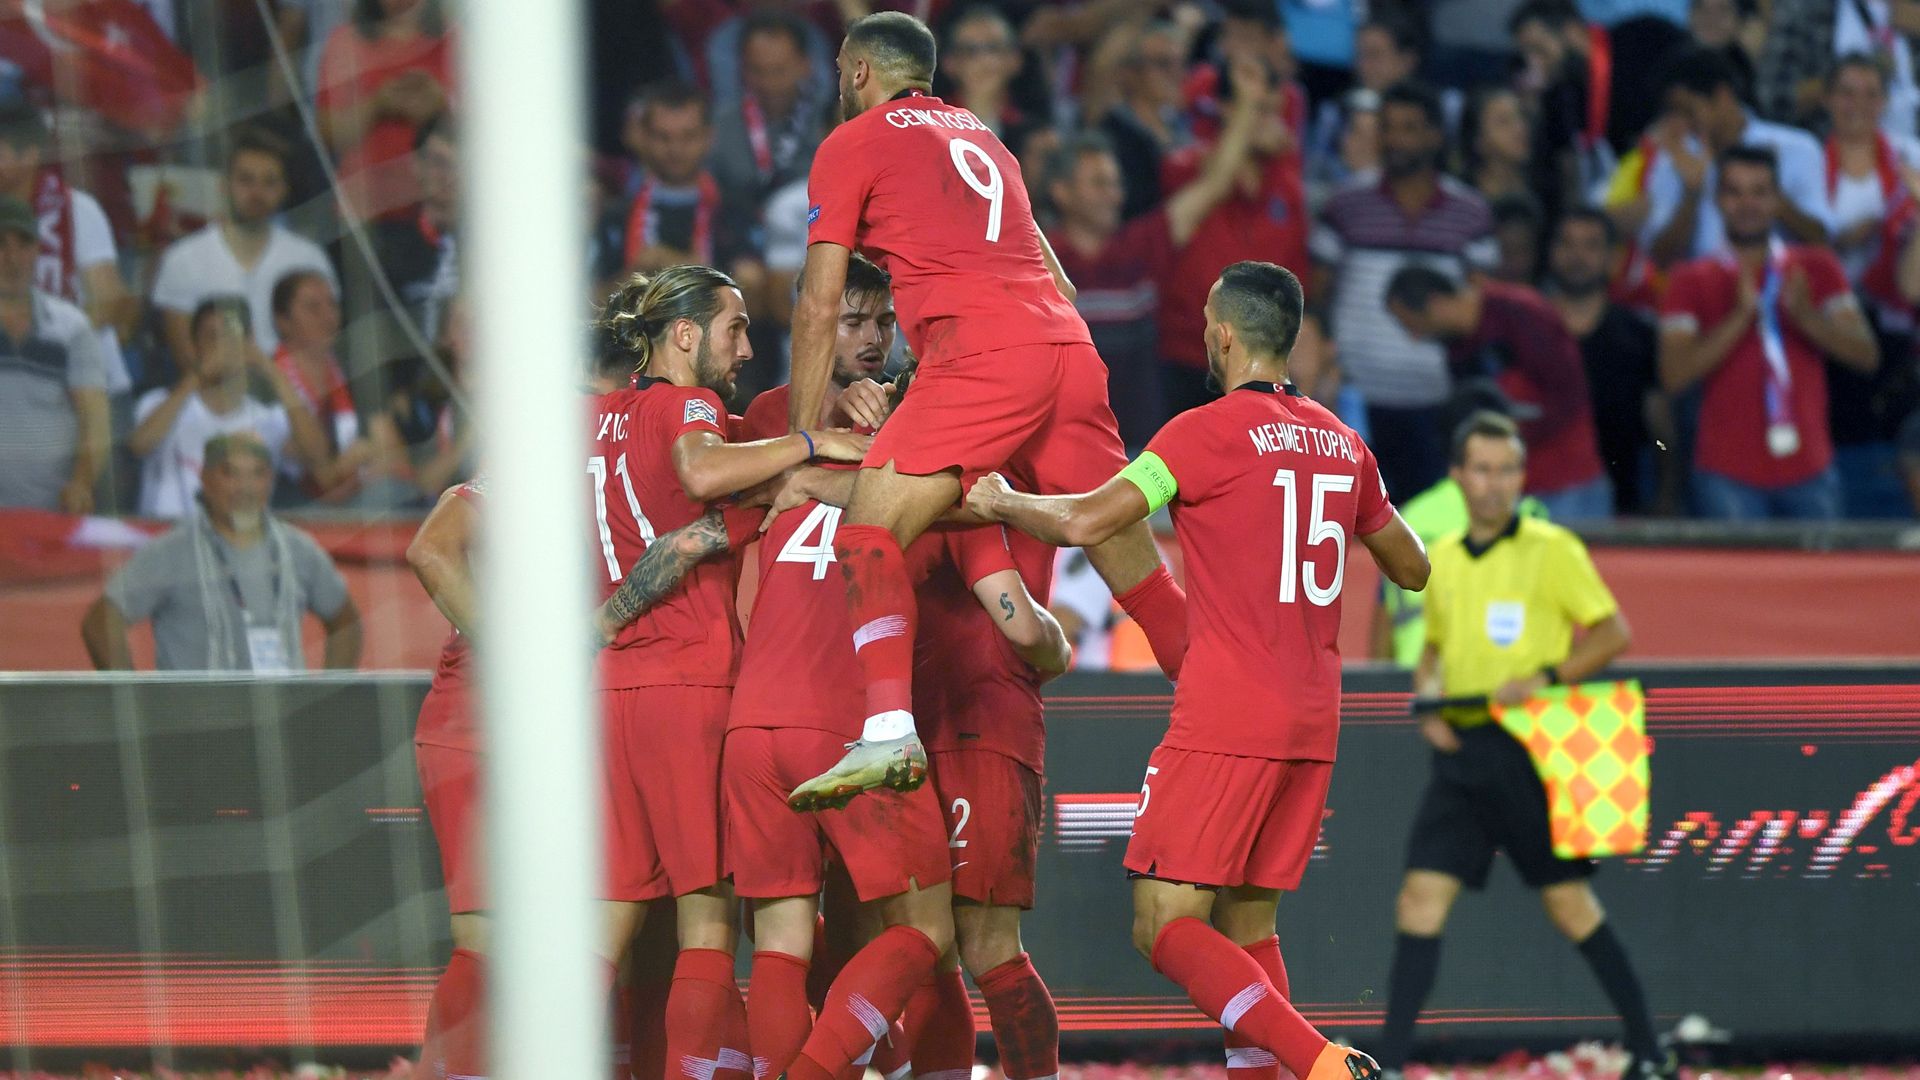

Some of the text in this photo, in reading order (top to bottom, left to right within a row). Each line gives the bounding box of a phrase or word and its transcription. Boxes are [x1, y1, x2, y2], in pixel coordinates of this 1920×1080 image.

[885, 108, 992, 132] CENK TOSU
[949, 138, 1004, 243] 9
[1248, 422, 1357, 464] MEHMET TOPAL
[586, 451, 658, 582] 11
[775, 502, 843, 580] 4
[1272, 468, 1355, 607] 15
[949, 797, 971, 848] 2
